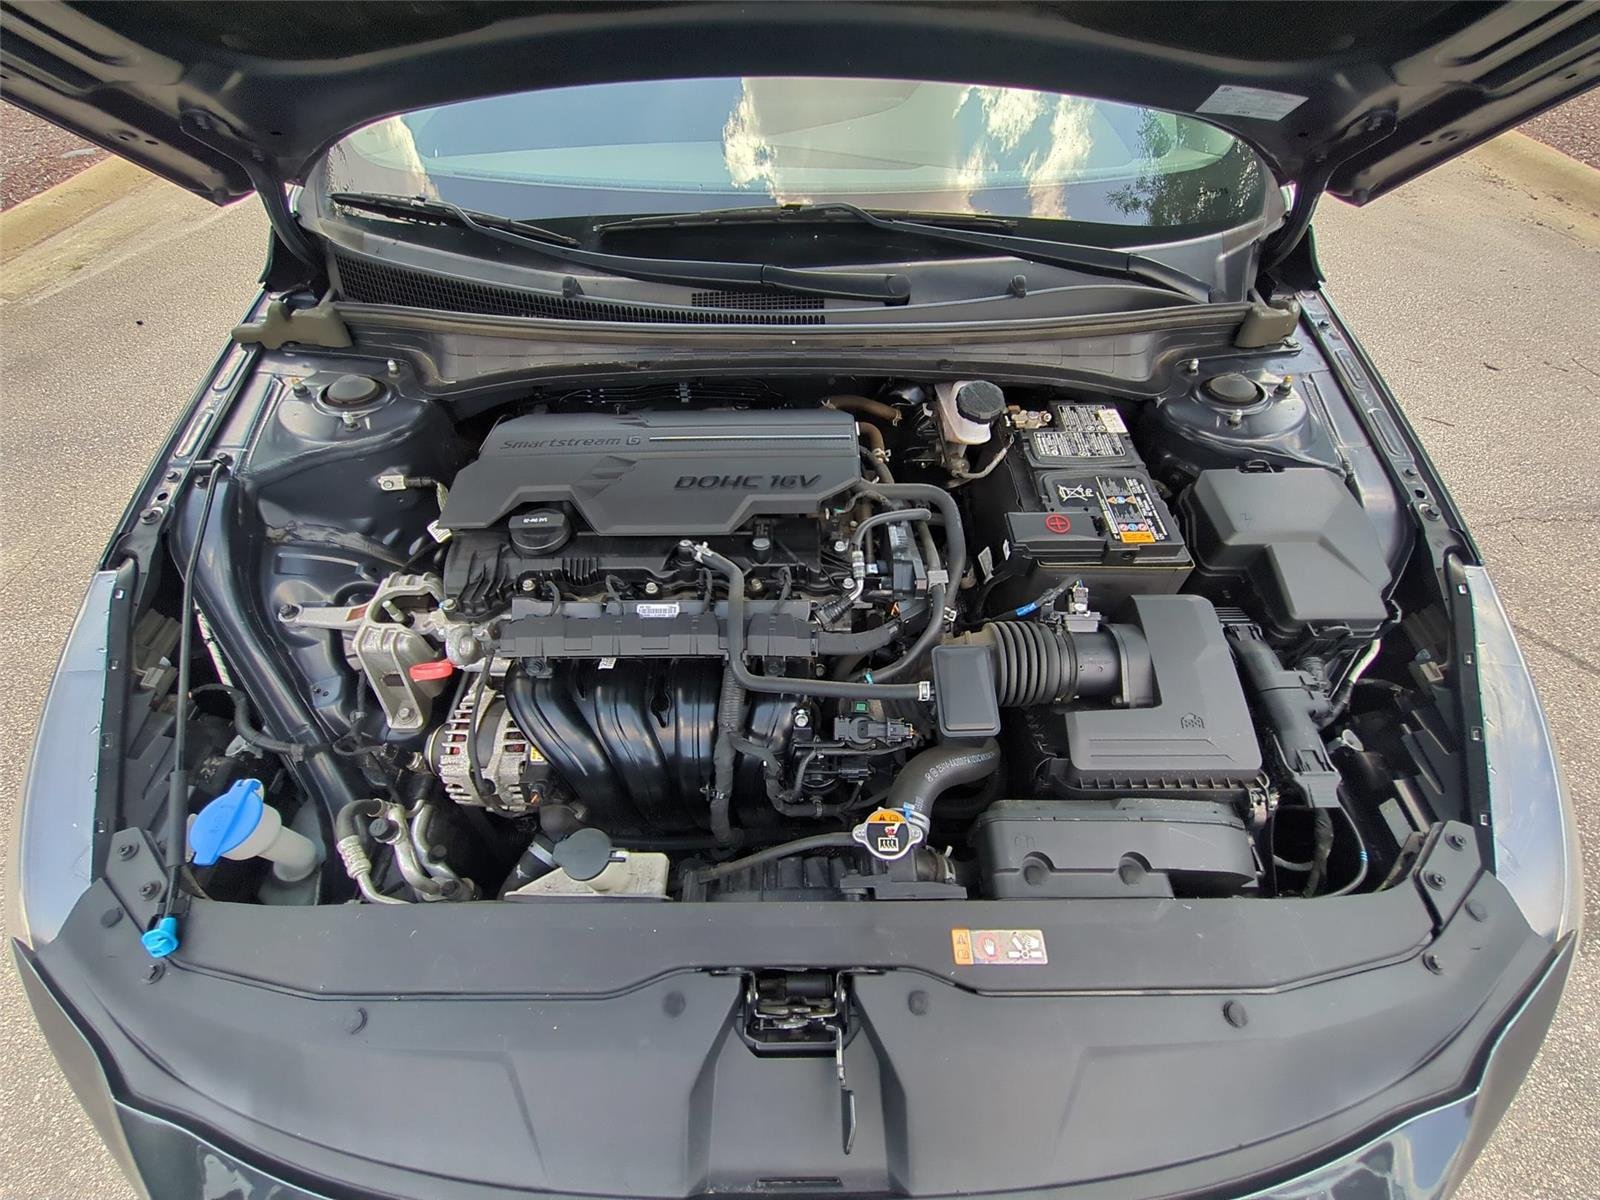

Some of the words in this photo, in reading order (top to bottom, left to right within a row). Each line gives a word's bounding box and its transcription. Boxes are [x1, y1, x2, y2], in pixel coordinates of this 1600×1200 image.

[500, 438, 621, 449] Smartstream
[674, 475, 763, 488] DOHC
[770, 474, 822, 488] 16V
